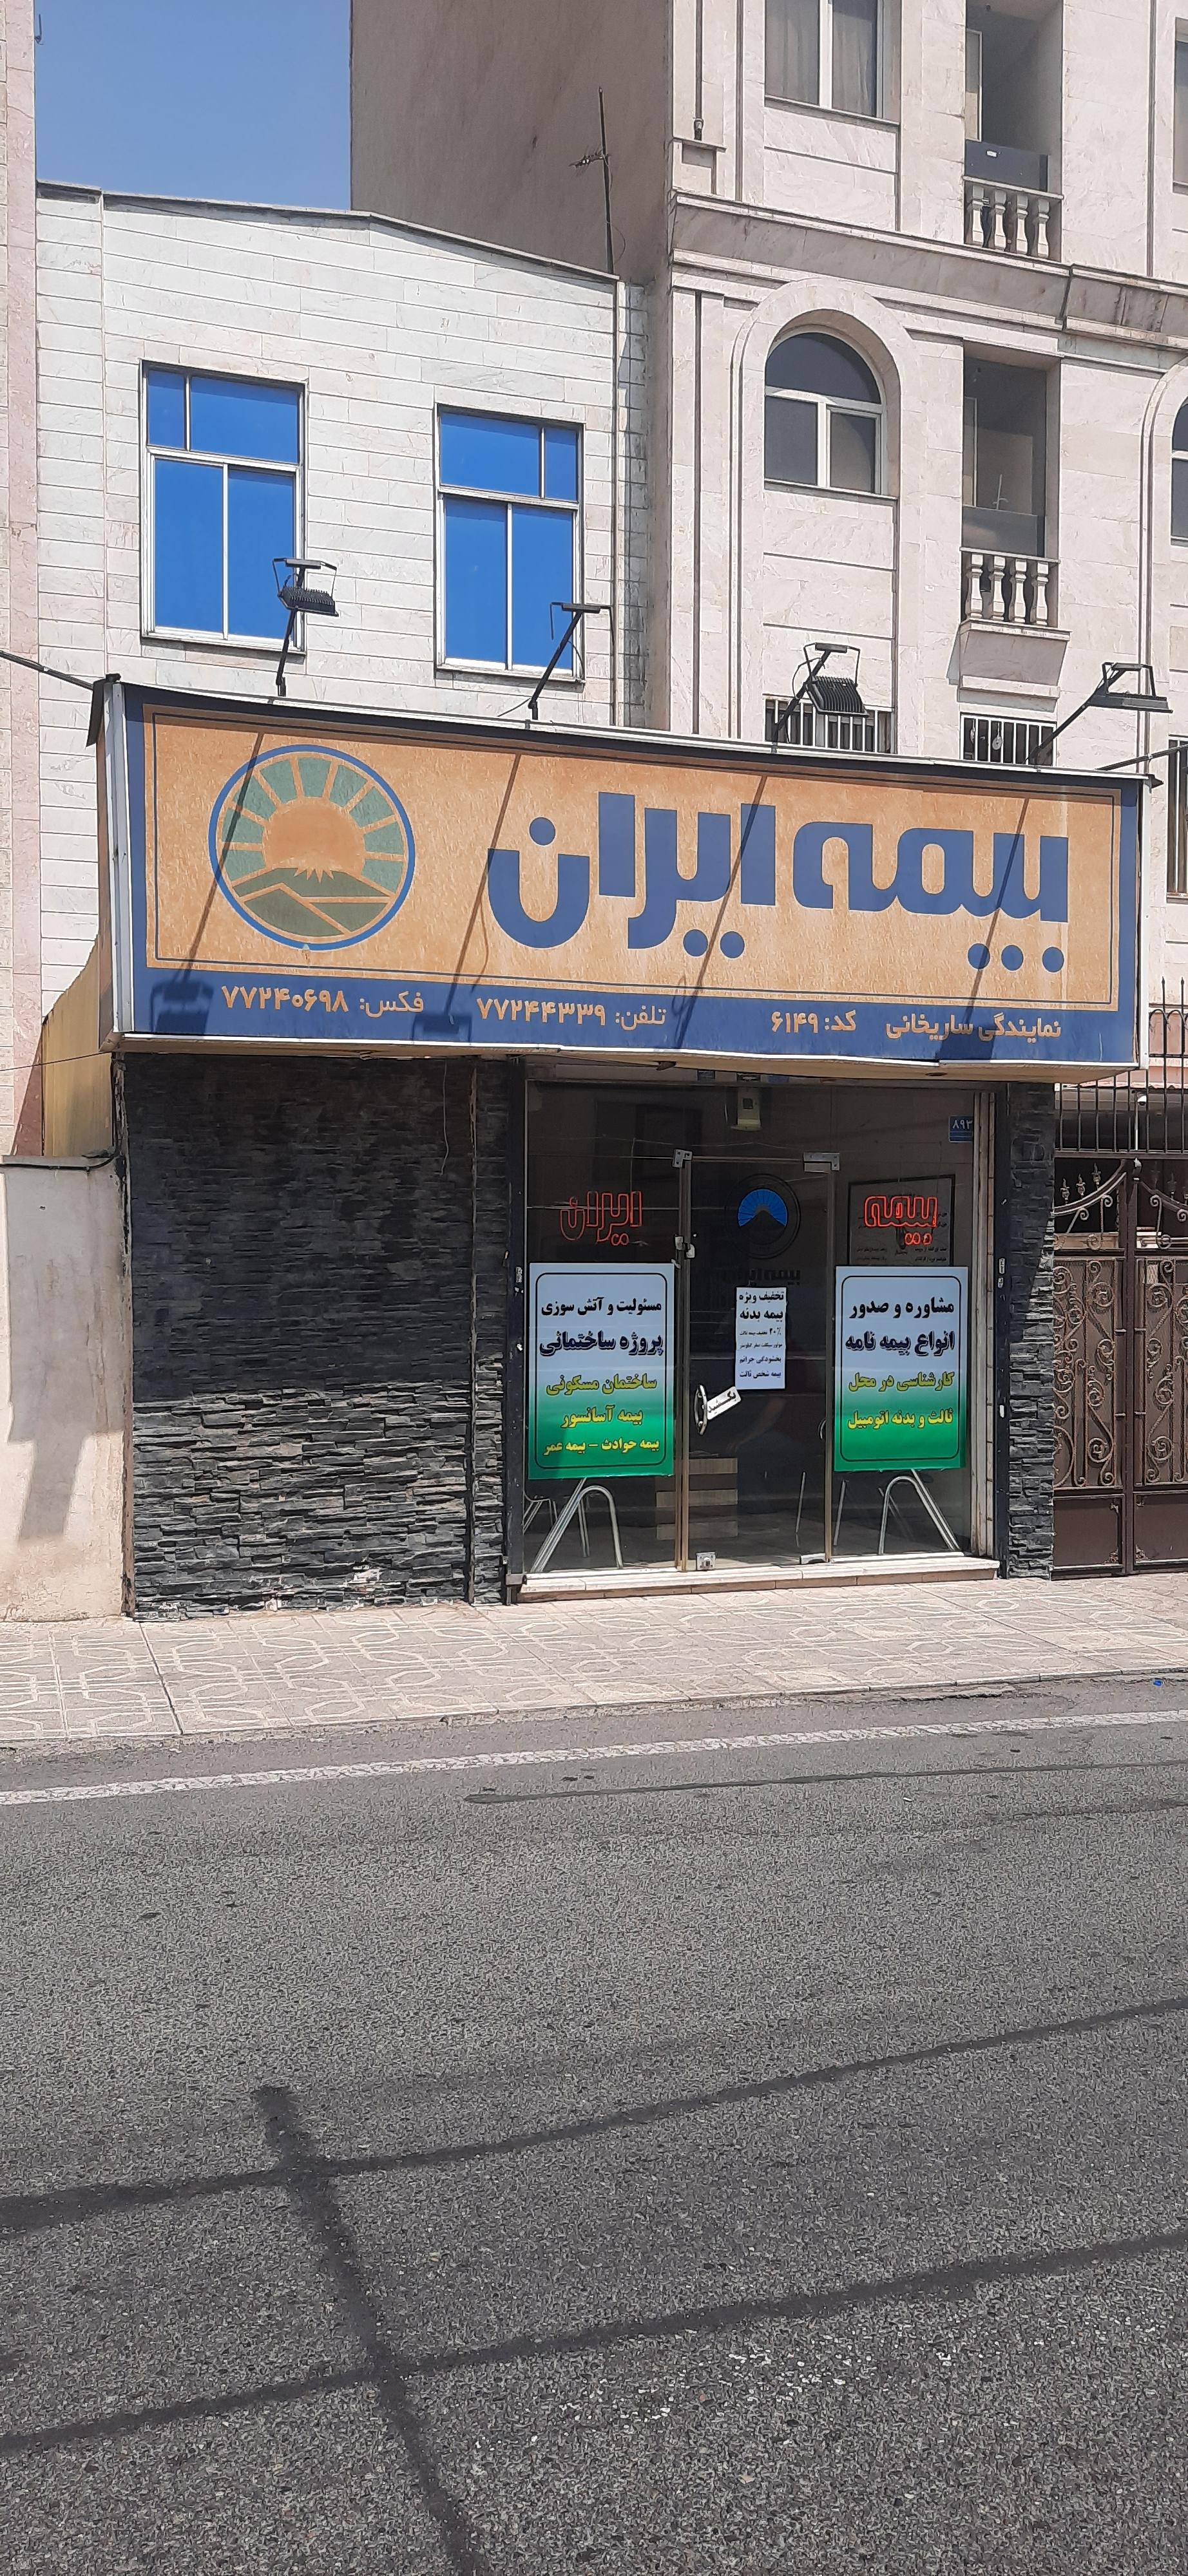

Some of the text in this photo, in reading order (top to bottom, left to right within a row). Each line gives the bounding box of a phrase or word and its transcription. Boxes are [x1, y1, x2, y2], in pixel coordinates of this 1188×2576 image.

[488, 791, 1068, 972] بیمه ایران
[221, 985, 1062, 1043] نمایندگی ساریخانی کد: ۶۱۴۹ تلفن: ۷۷۲۴۴۳۳۹ فکس: ۷۷۲۴۰۶۹۸
[560, 1191, 938, 1245] بیمه ایران
[541, 1296, 662, 1316] مسئولیت و آتش سوزی
[739, 1291, 785, 1304] تخفیف ویژه
[849, 1296, 955, 1318] مشاوره و صدور
[740, 1307, 783, 1322] بیمه بدنه
[539, 1330, 664, 1357] پروژه ساختمانی
[845, 1331, 955, 1356] انواع بیمه نامه
[756, 1355, 781, 1364] بخشودگی
[546, 1373, 658, 1396] ساختمان مسکونی
[753, 1370, 770, 1379] شخص
[848, 1371, 955, 1392] کارشناسی در محل
[560, 1405, 644, 1428] بیمه آسانسور
[847, 1407, 953, 1430] ثالث و بدنه اتومبیل
[543, 1441, 563, 1455] عمر
[565, 1440, 586, 1455] بیمه
[601, 1437, 637, 1454] حوادث
[640, 1438, 660, 1454] بیمه
